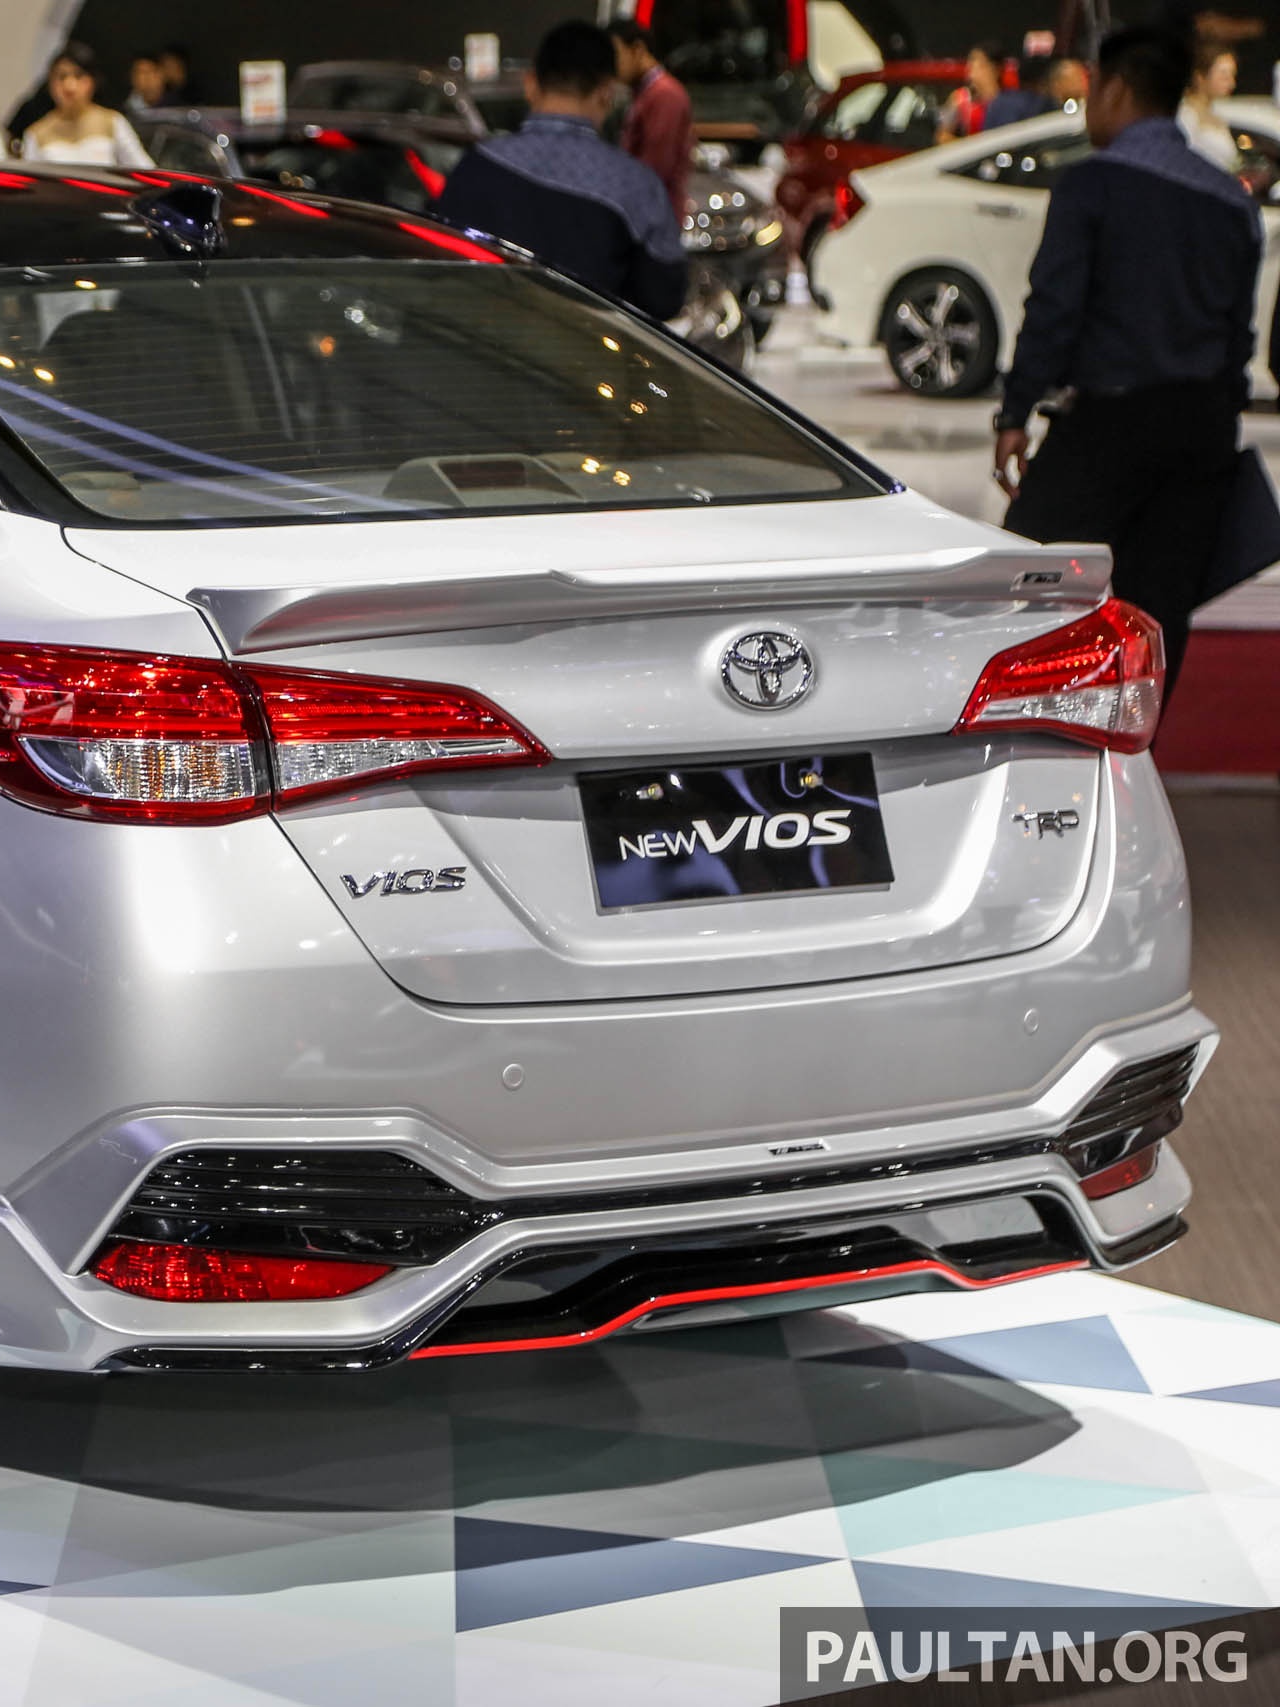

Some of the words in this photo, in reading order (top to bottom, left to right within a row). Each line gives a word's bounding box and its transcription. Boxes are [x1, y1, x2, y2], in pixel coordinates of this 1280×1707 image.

[618, 829, 697, 861] NEW
[691, 809, 852, 855] VIOS
[339, 865, 468, 900] VIOS
